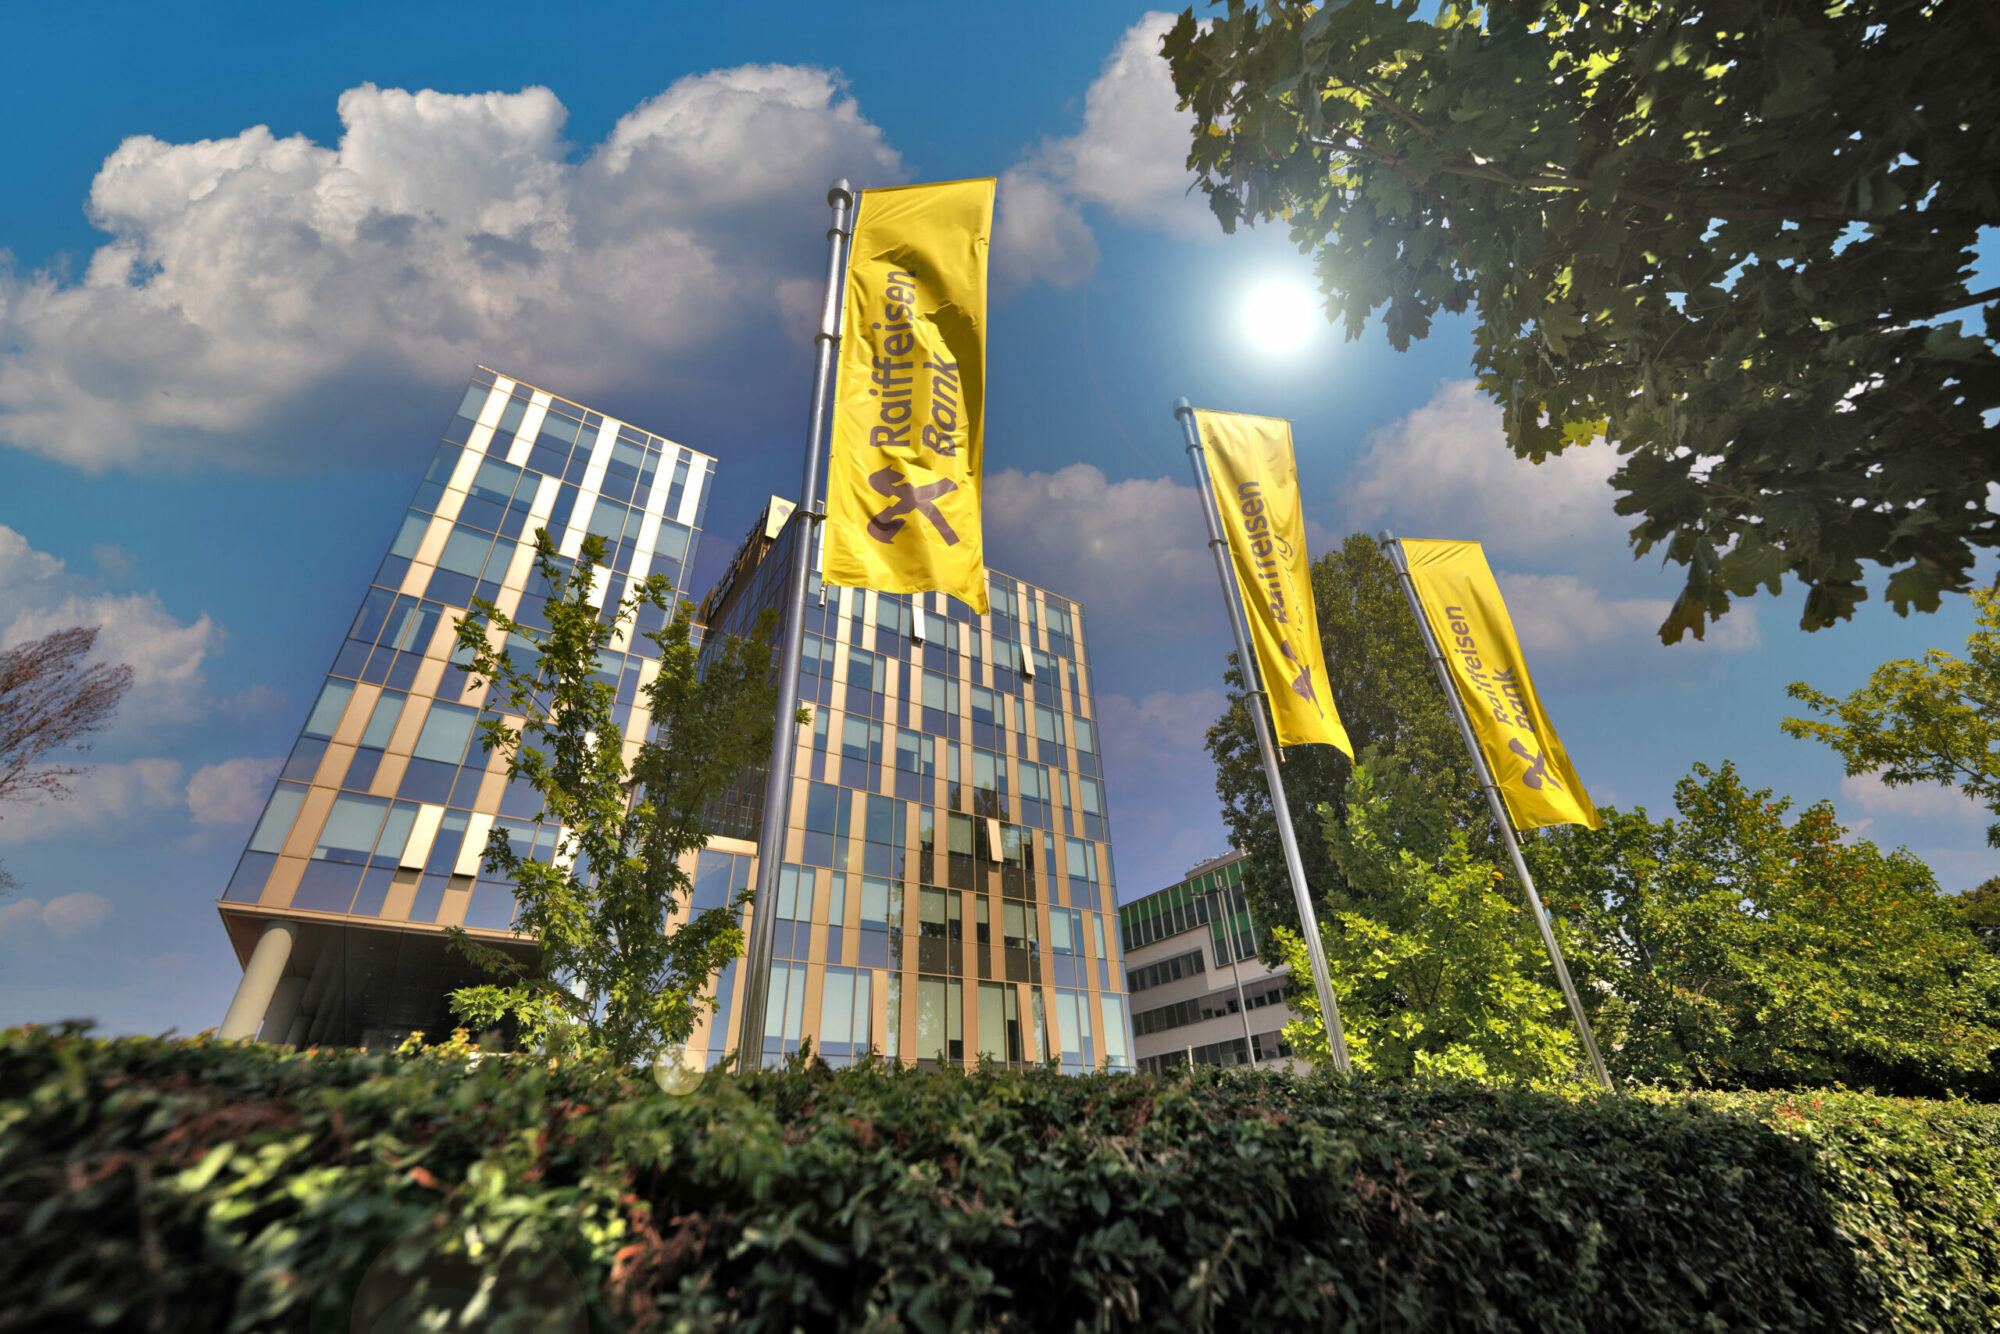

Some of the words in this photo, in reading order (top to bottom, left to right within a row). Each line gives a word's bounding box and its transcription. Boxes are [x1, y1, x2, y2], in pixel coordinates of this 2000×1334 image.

[869, 270, 916, 447] Raiffeisen
[923, 352, 959, 456] Bank
[1446, 606, 1513, 725] Raiffeisen
[1492, 667, 1535, 733] Bank
